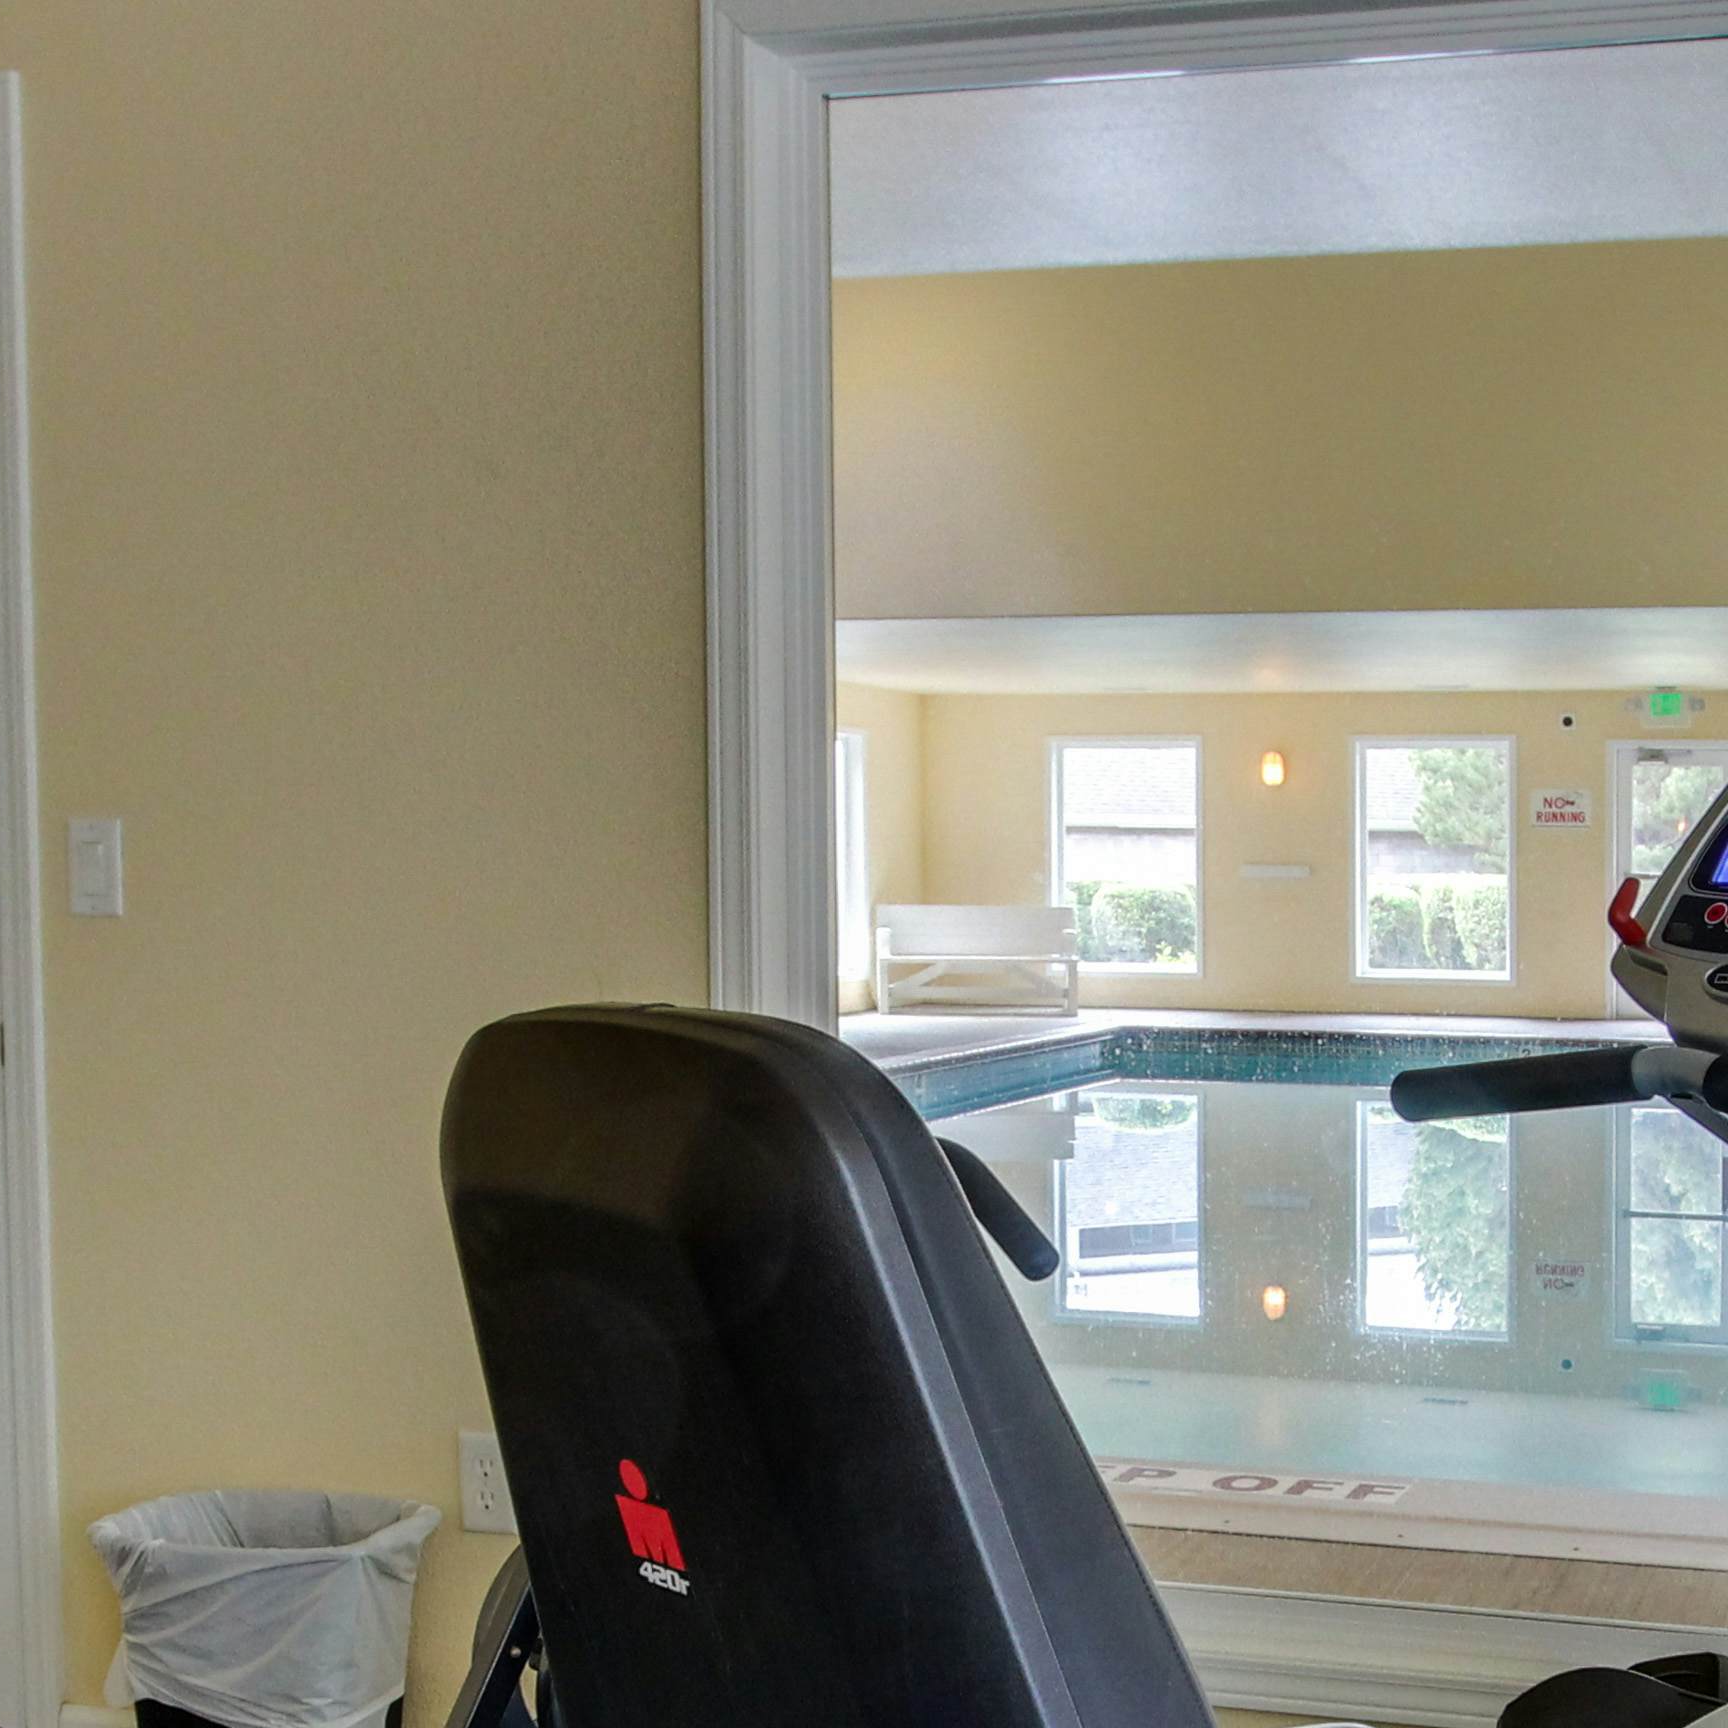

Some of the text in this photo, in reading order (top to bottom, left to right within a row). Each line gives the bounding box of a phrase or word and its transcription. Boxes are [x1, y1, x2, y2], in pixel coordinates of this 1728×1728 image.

[1543, 797, 1567, 810] NO
[1536, 811, 1586, 824] RUNNING
[1212, 1474, 1407, 1501] OFF
